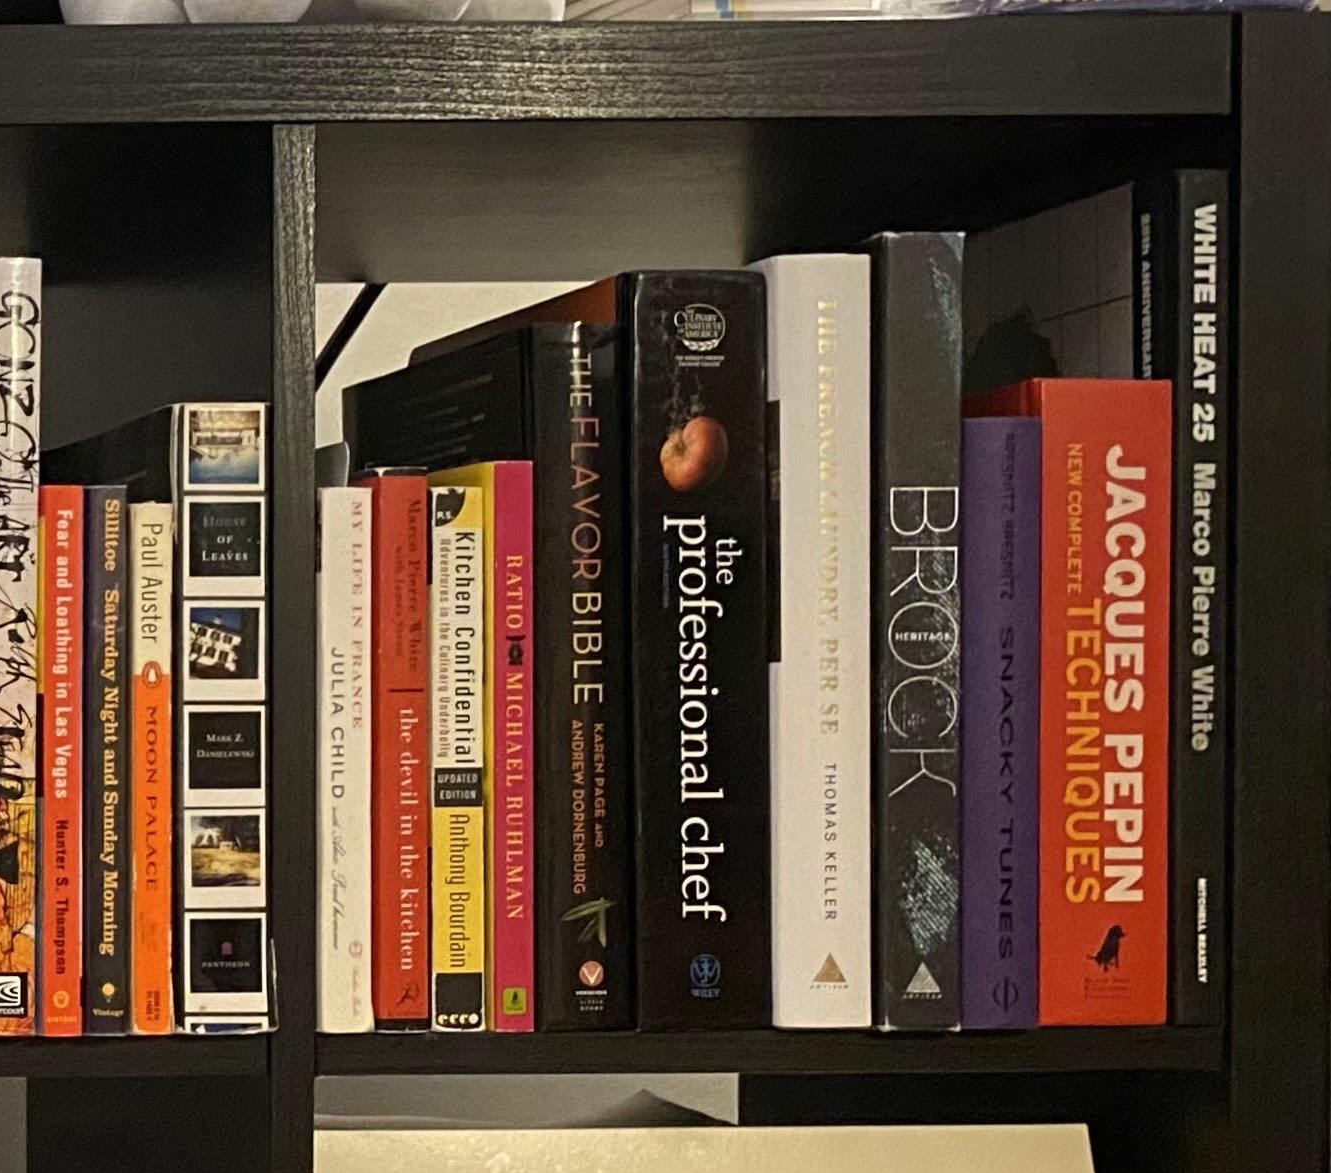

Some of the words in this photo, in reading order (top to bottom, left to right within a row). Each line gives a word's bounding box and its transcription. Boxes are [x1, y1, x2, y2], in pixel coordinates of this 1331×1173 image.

[1193, 204, 1217, 304] WHITE
[1193, 314, 1217, 394] HEAT
[1193, 403, 1216, 443] 25
[57, 509, 74, 550] Fear
[570, 418, 601, 579] FLAVOR
[1192, 464, 1216, 557] Marco
[56, 555, 73, 589] and
[141, 523, 162, 568] Paul
[455, 532, 475, 615] Kitchen
[715, 538, 742, 585] the
[1104, 445, 1147, 714] JACQUES
[142, 576, 162, 643] Auster
[506, 555, 523, 629] RATIO
[1192, 567, 1216, 657] Pierre
[53, 595, 73, 676] Loathing
[571, 593, 602, 704] BIBLE
[663, 515, 725, 803] professional
[888, 487, 958, 796] BROCK
[55, 682, 72, 699] in
[55, 707, 72, 737] Las
[455, 627, 475, 763] Confidential
[506, 674, 523, 786] MICHAEL
[1191, 665, 1215, 751] White
[52, 744, 72, 799] Vegas
[438, 773, 477, 783] UPDATED
[1064, 598, 1100, 904] TECHNIQUES
[440, 791, 476, 799] EDITION
[824, 763, 837, 842] THOMAS
[1104, 734, 1144, 903] PEPIN
[445, 814, 470, 890] Anthony
[506, 797, 523, 919] RUHLMAN
[680, 816, 727, 922] chef
[824, 852, 837, 921] KELLER
[450, 892, 470, 968] Bourdain
[438, 1013, 478, 1024] ecco
